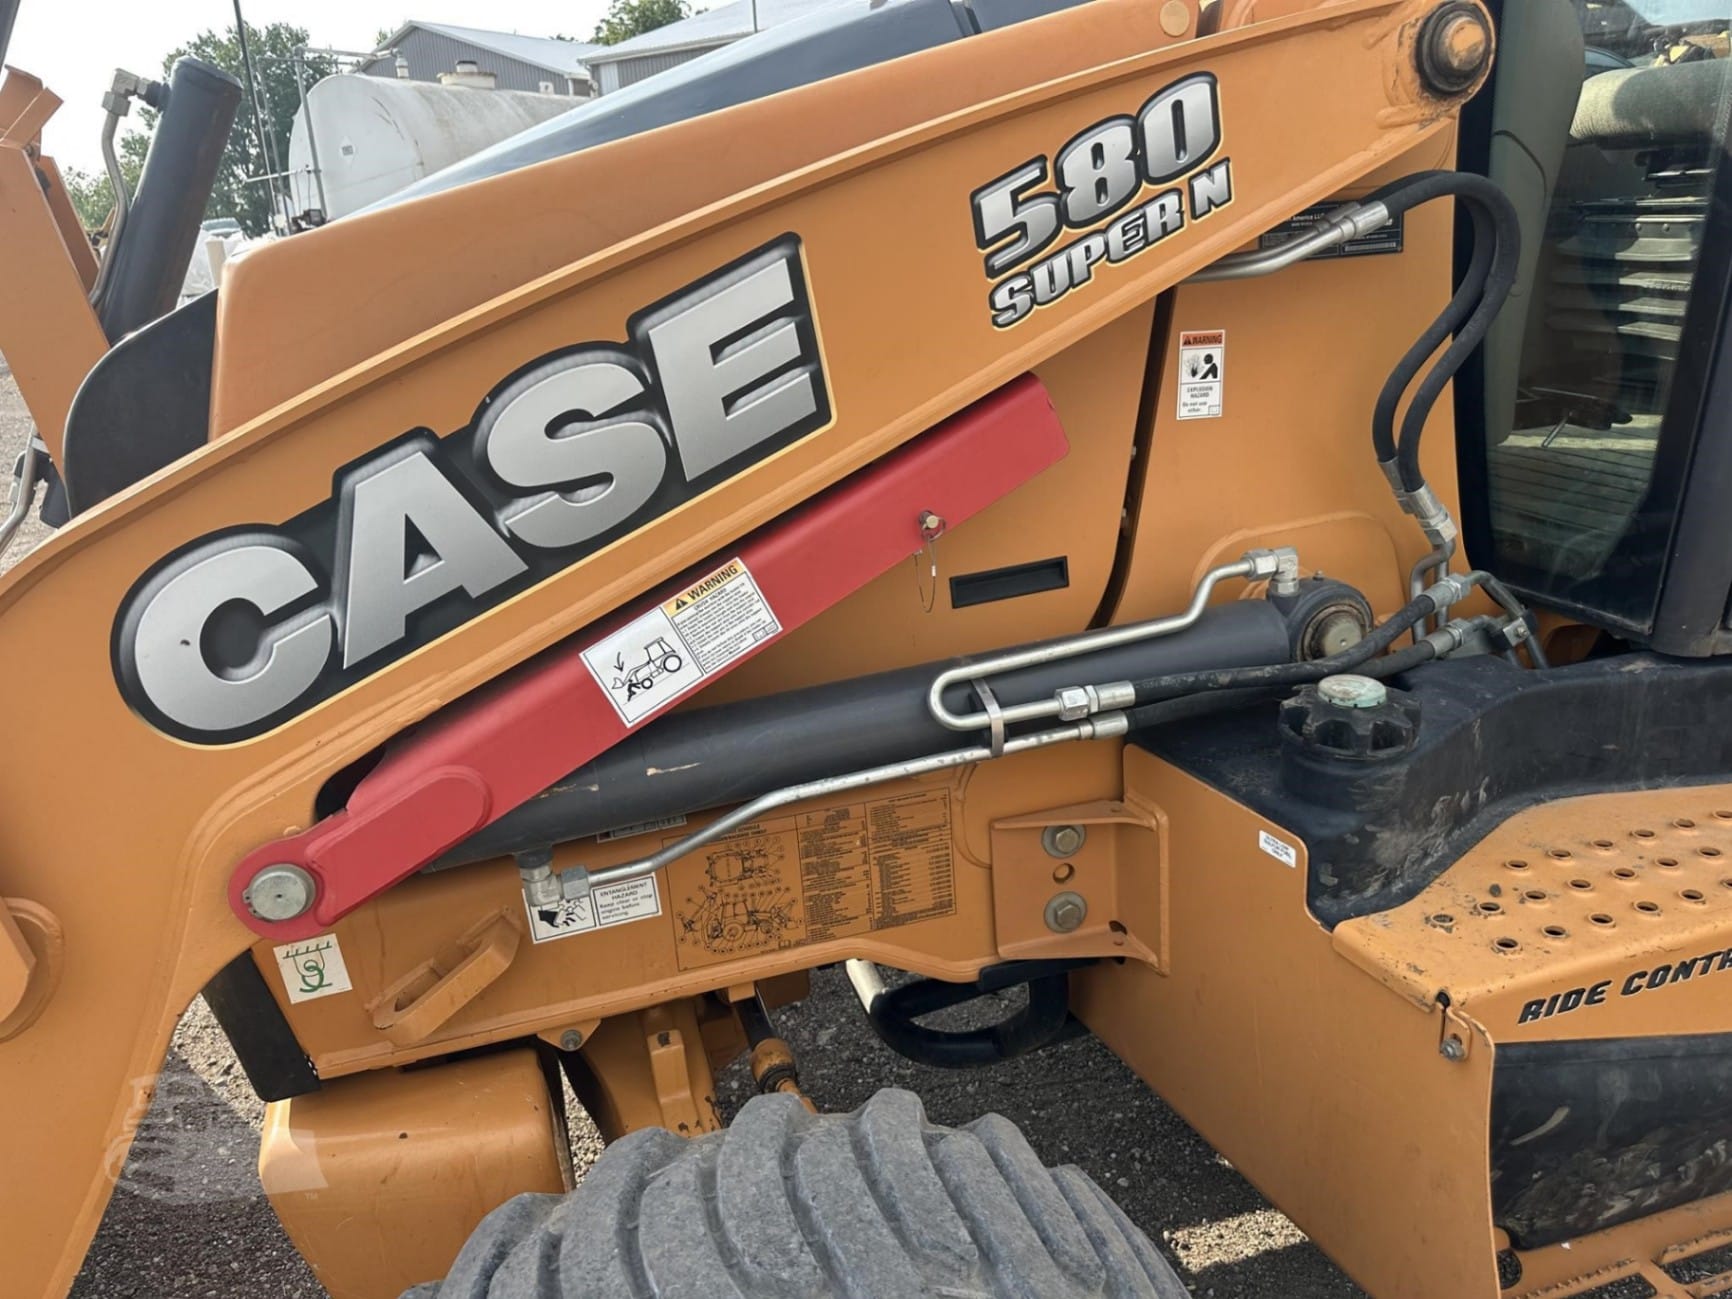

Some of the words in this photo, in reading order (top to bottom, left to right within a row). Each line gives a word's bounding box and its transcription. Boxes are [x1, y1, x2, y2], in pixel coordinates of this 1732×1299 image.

[970, 71, 1221, 279] 580
[988, 188, 1184, 328] SUPER
[1187, 157, 1233, 221] N
[1192, 335, 1222, 345] WARNING
[112, 233, 831, 742] CASE
[687, 564, 738, 601] WARNING
[600, 882, 647, 897] ENTANGLEMENT
[611, 890, 638, 900] HAZARD
[1518, 980, 1613, 1025] RIDE
